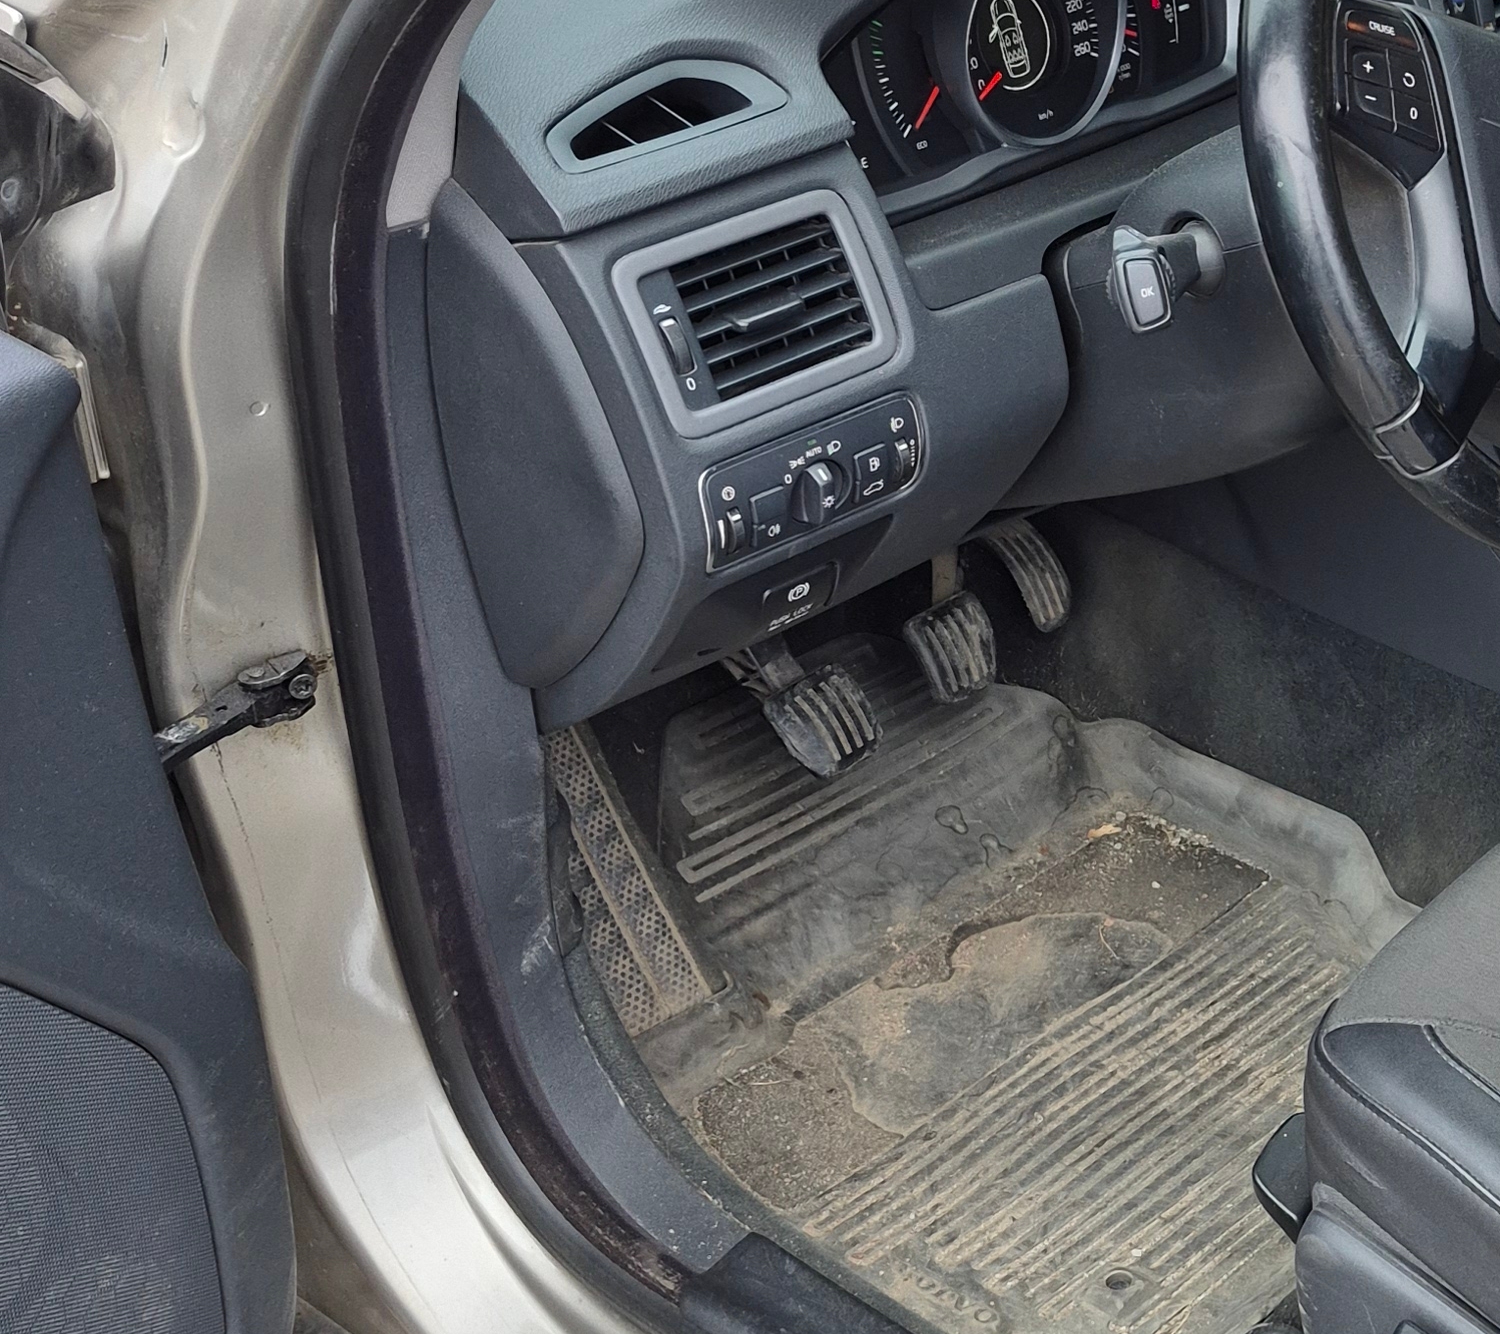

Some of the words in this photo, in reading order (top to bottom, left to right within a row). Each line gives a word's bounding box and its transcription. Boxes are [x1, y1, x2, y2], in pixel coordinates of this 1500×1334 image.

[1071, 19, 1088, 34] 240
[1368, 20, 1396, 36] CRUISE
[1073, 41, 1091, 57] 260
[861, 157, 869, 168] E
[1141, 286, 1155, 298] OK
[686, 377, 697, 391] 0
[805, 446, 823, 458] AUTO
[903, 1272, 998, 1323] OLVO
